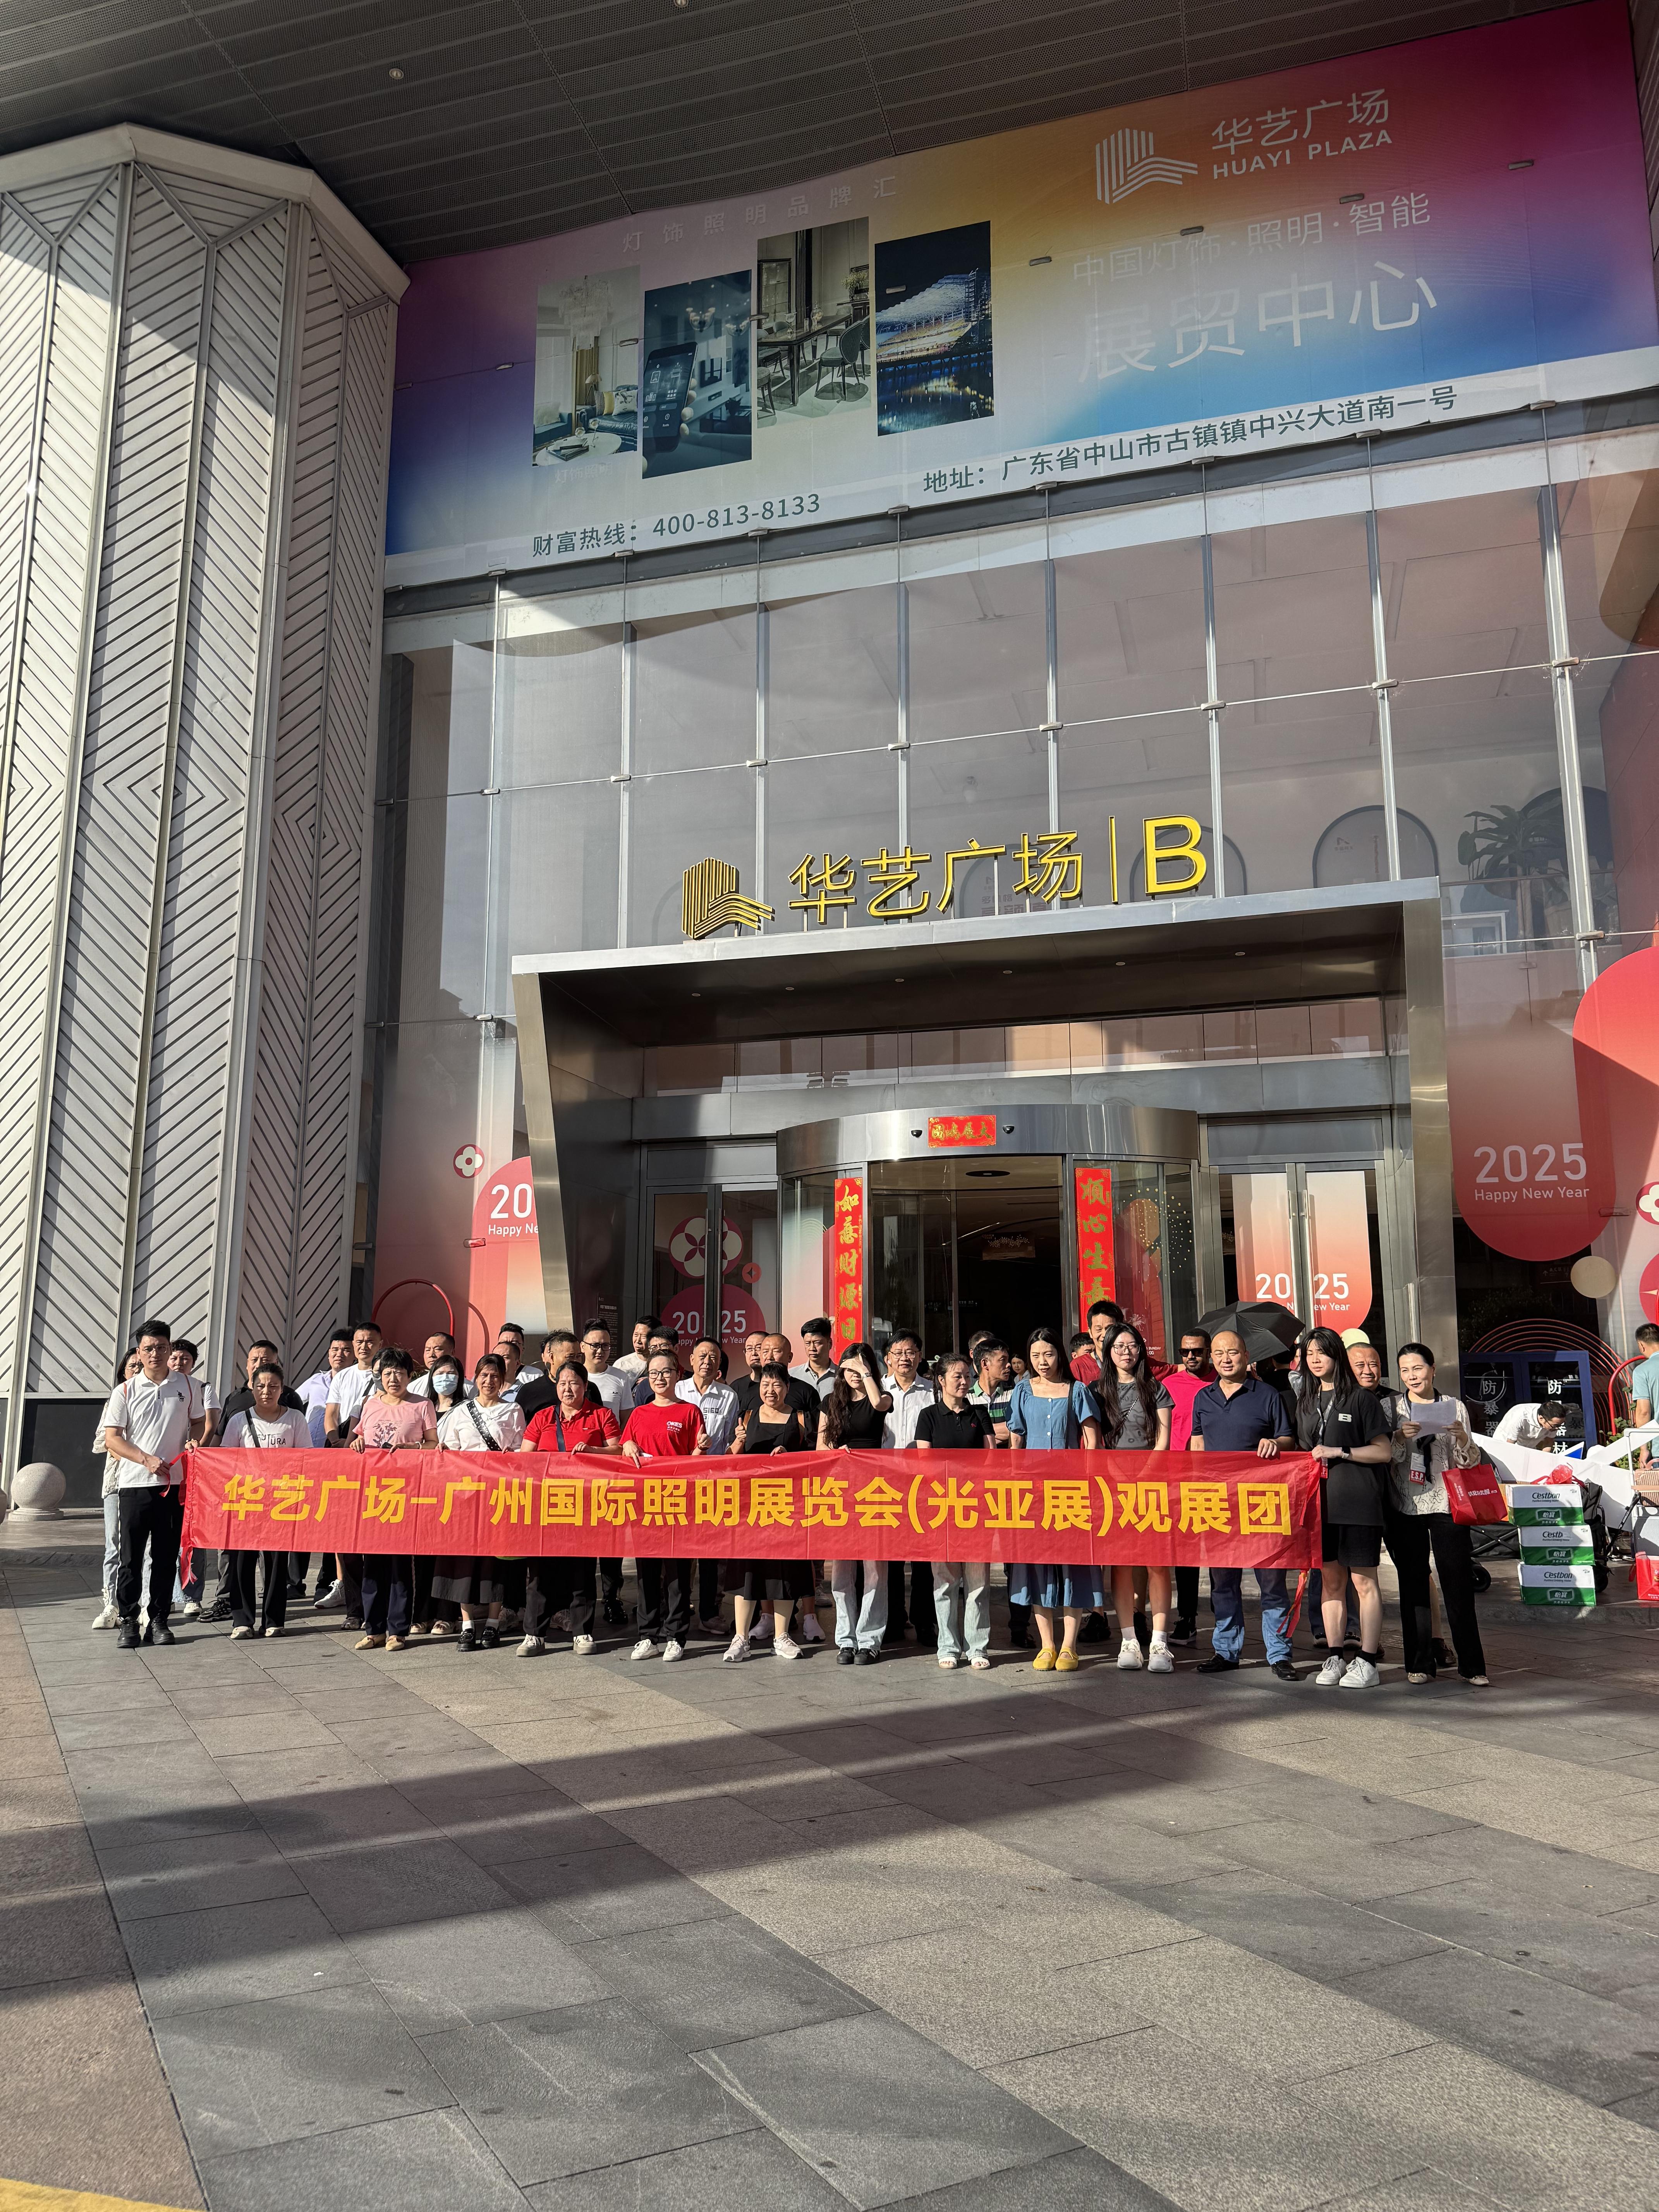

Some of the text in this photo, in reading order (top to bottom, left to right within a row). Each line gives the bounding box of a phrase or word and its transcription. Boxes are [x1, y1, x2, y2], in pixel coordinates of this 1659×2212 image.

[1211, 88, 1390, 155] 华艺广场
[1212, 129, 1393, 180] HUAYI PLAZA
[622, 176, 897, 253] 灯饰照明品牌汇
[1079, 260, 1437, 383] 展贸中心
[555, 462, 613, 484] 灯饰照明
[788, 814, 1207, 926] 华艺广场 B
[1474, 1143, 1587, 1183] 2025
[490, 1183, 532, 1219] 20
[1474, 1186, 1590, 1203] Happy New Year
[488, 1224, 522, 1238] Happy
[1329, 1302, 1351, 1311] Year
